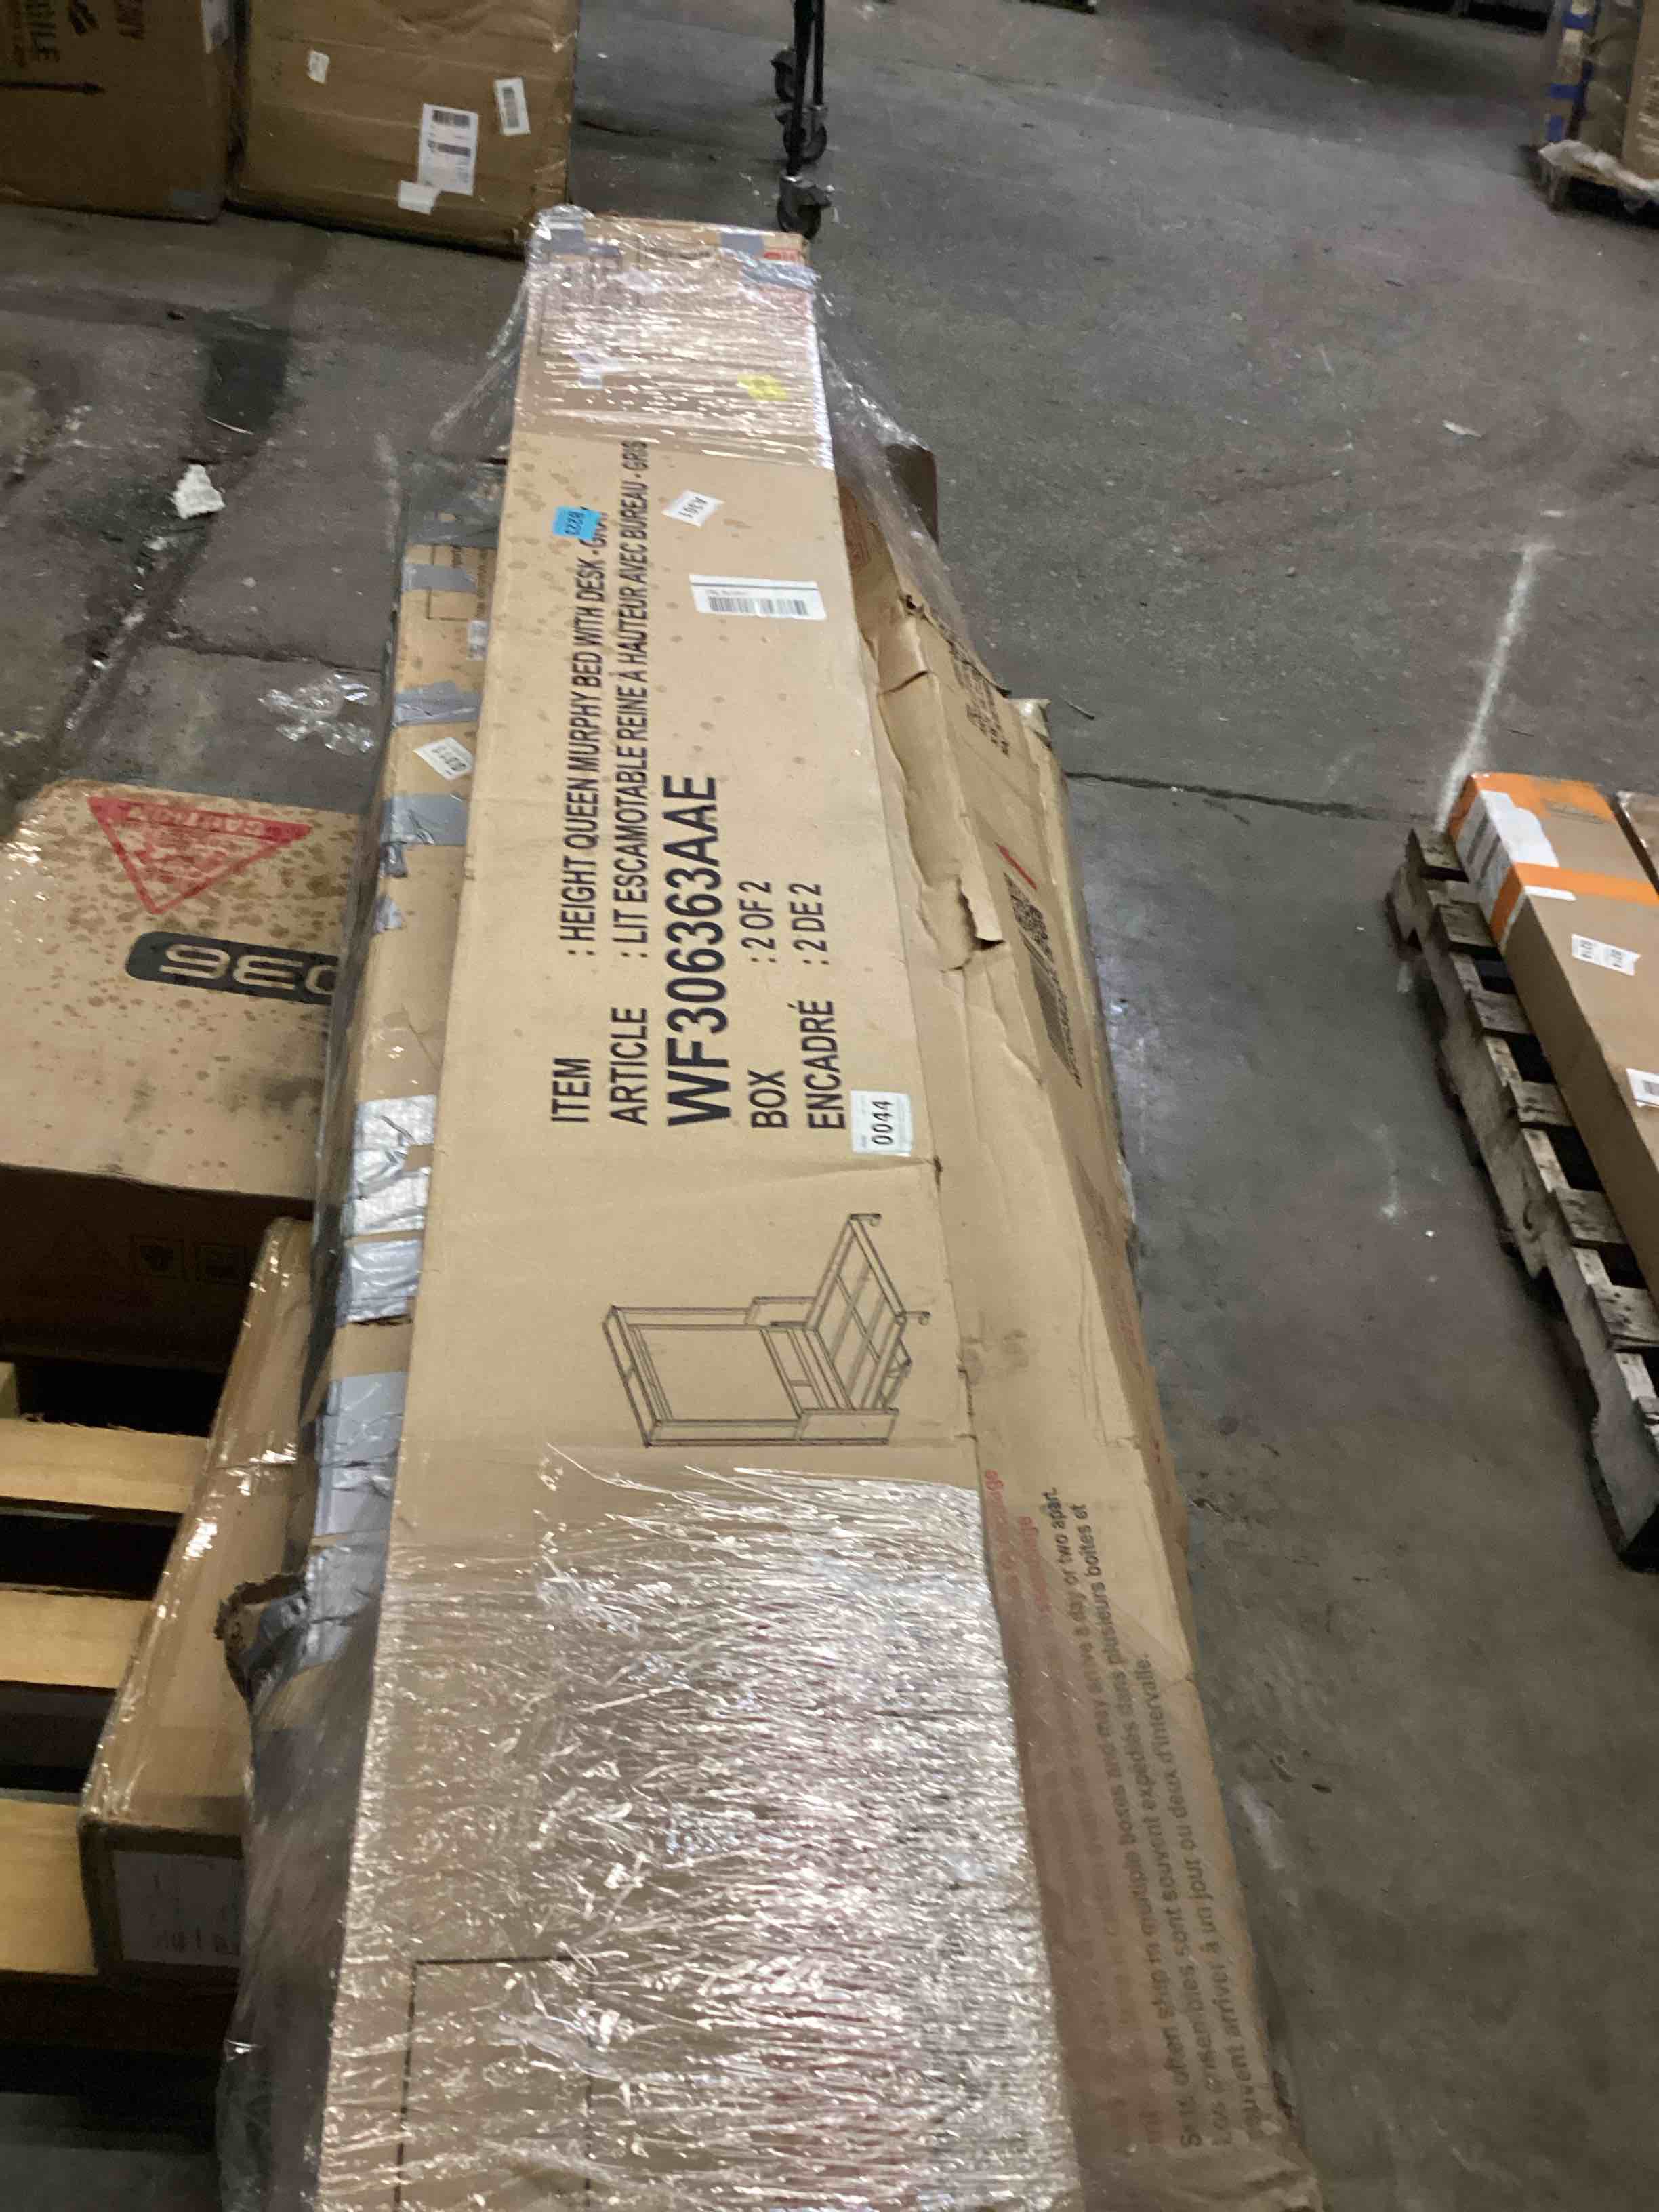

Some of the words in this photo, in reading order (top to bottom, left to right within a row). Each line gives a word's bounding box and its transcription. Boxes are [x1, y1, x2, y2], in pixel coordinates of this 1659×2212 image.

[620, 439, 649, 471] GRIS
[619, 480, 648, 539] BUREAU
[575, 558, 605, 602] DESK
[617, 542, 648, 584] AVEC
[573, 606, 604, 647] WITH
[617, 585, 648, 665] HAUTEUR
[570, 651, 602, 688] BED
[566, 691, 602, 773] MURPHY
[615, 685, 648, 741] REINE
[563, 777, 599, 849] QUEEN
[612, 745, 648, 903] ESCAMOTABLE
[558, 855, 596, 941] HEIGHT
[737, 880, 771, 894] 2
[787, 882, 821, 897] 2
[612, 909, 648, 944] LIT
[737, 899, 774, 930] OF
[790, 901, 825, 933] DE
[661, 775, 731, 1127] WF306363AAE
[740, 936, 775, 951] 2
[792, 939, 828, 953] 2
[609, 1008, 647, 1126] ARTICLE
[787, 1000, 846, 1130] ENCADRÉ
[550, 1057, 591, 1123] ITEM
[747, 1069, 789, 1129] BOX
[871, 1100, 893, 1145] 0044
[1070, 1503, 1088, 1519] et
[1054, 1534, 1073, 1563] two
[1062, 1570, 1078, 1584] or
[1065, 1591, 1086, 1622] day
[1088, 1582, 1124, 1666] plusieurs
[1164, 1770, 1188, 1818] deux
[1142, 1816, 1178, 1901] souvent
[1176, 1824, 1198, 1851] ou
[1183, 1858, 1214, 1901] jour
[1164, 1908, 1189, 1957] sont
